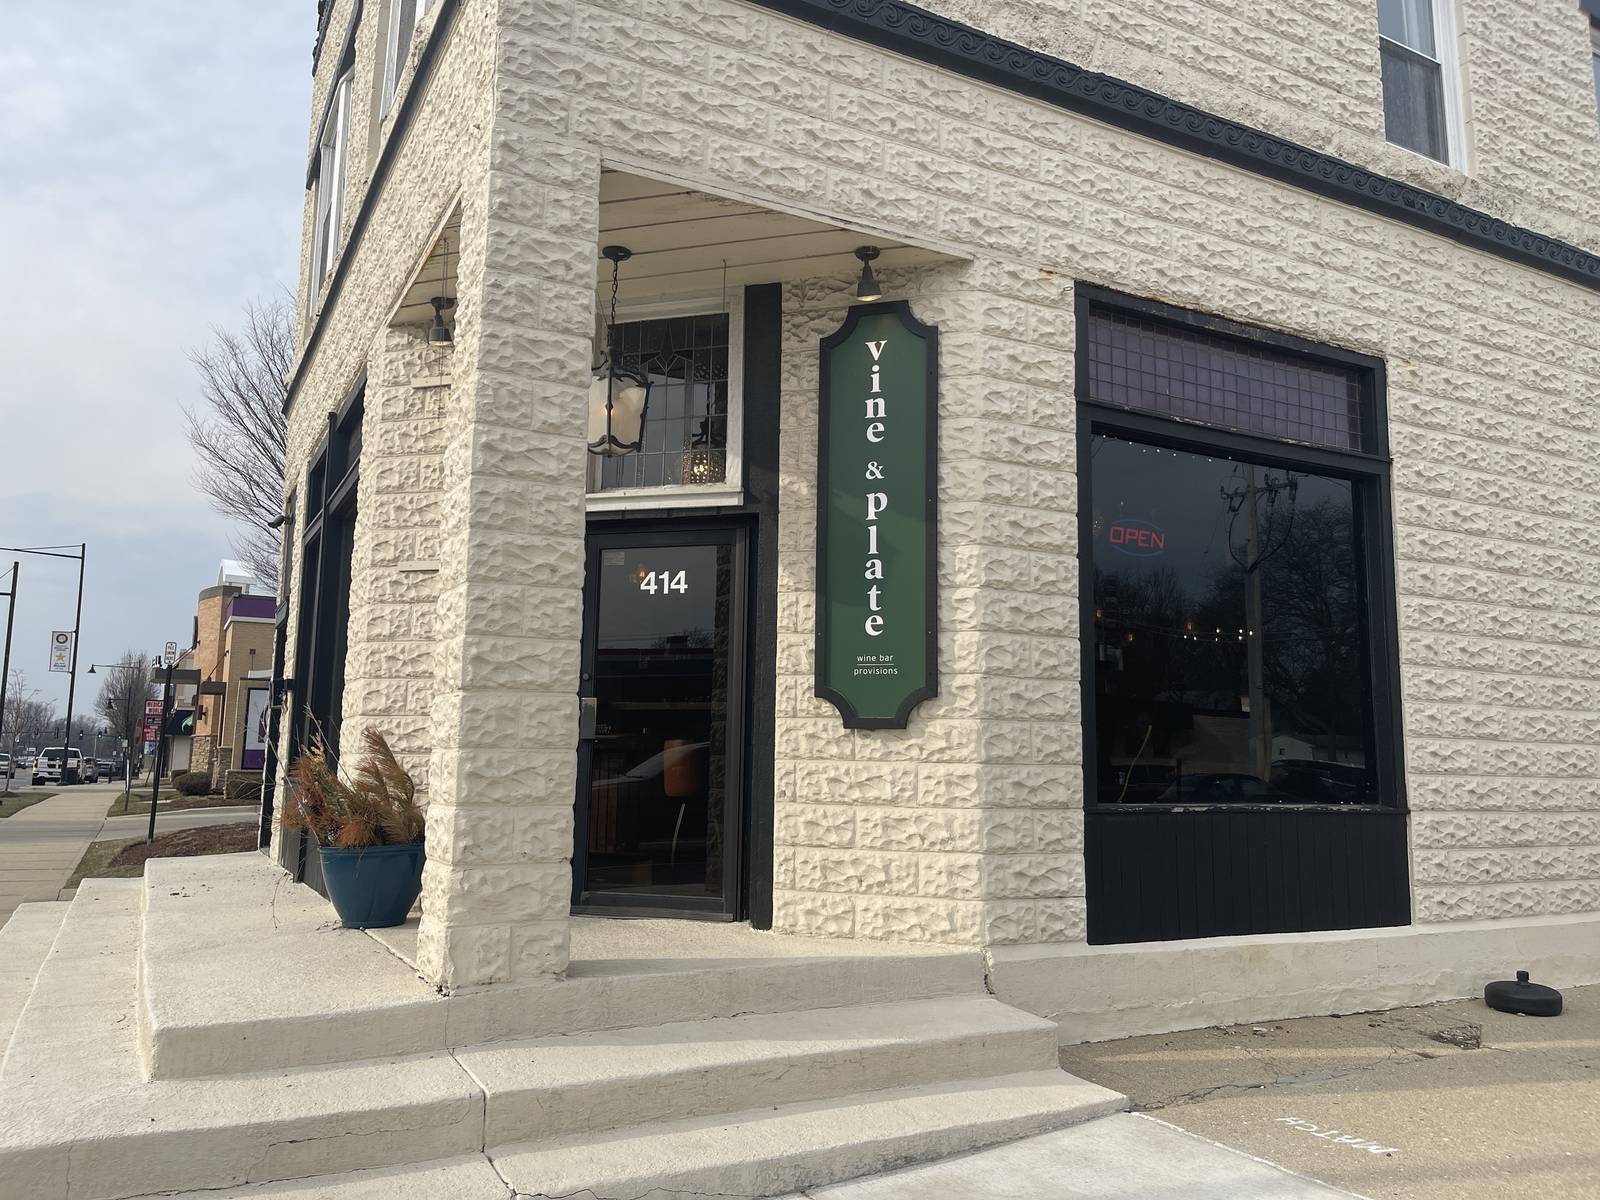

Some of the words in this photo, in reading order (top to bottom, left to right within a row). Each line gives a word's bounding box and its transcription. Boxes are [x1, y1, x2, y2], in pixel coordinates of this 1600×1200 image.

[865, 340, 887, 443] vine
[865, 461, 885, 480] &
[1109, 526, 1167, 551] OPEN
[864, 491, 888, 637] plate
[640, 570, 688, 595] 414
[857, 654, 876, 662] wine
[879, 654, 894, 662] bar
[854, 667, 898, 676] provisions
[1275, 1117, 1400, 1153] WATCH
